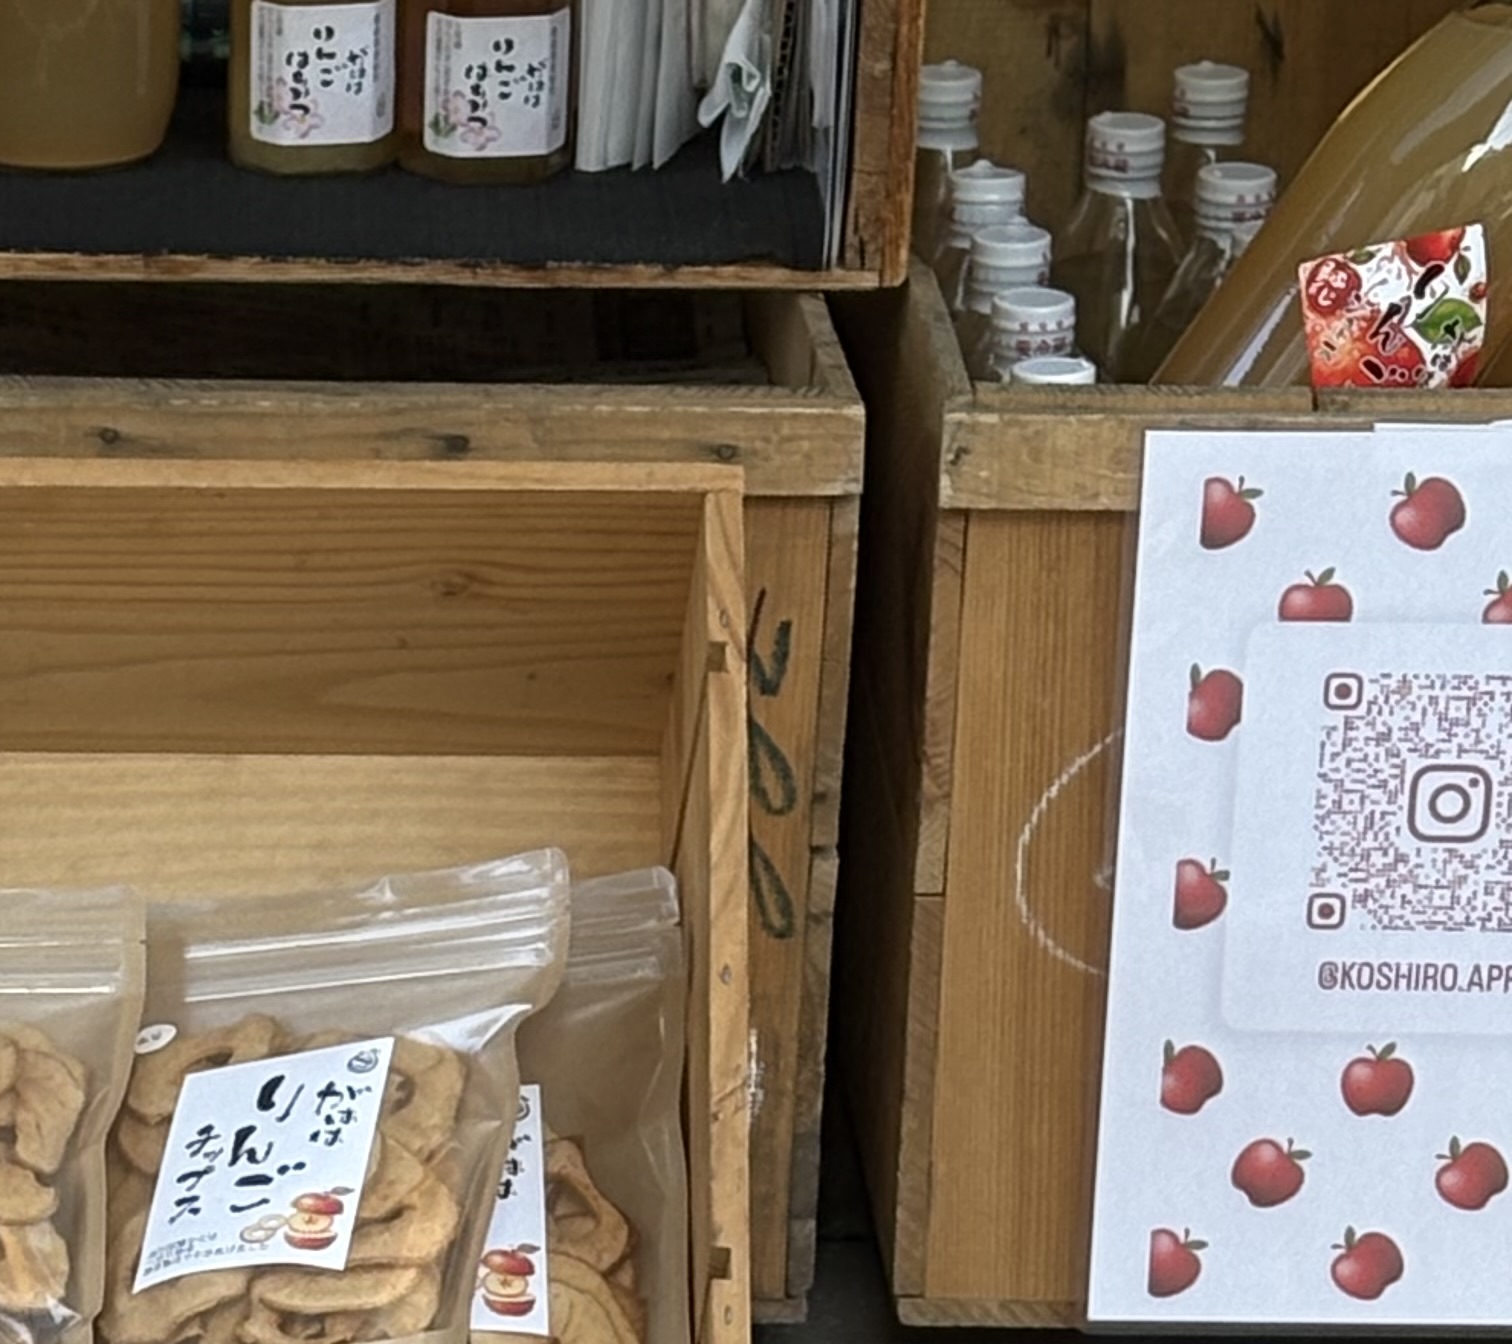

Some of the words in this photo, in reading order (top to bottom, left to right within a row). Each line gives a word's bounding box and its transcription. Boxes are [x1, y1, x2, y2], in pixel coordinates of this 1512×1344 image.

[313, 25, 349, 88] りんご
[492, 38, 527, 100] りんご
[227, 1075, 307, 1213] りんご
[309, 1081, 372, 1147] がはは
[168, 1124, 224, 1225] チップス
